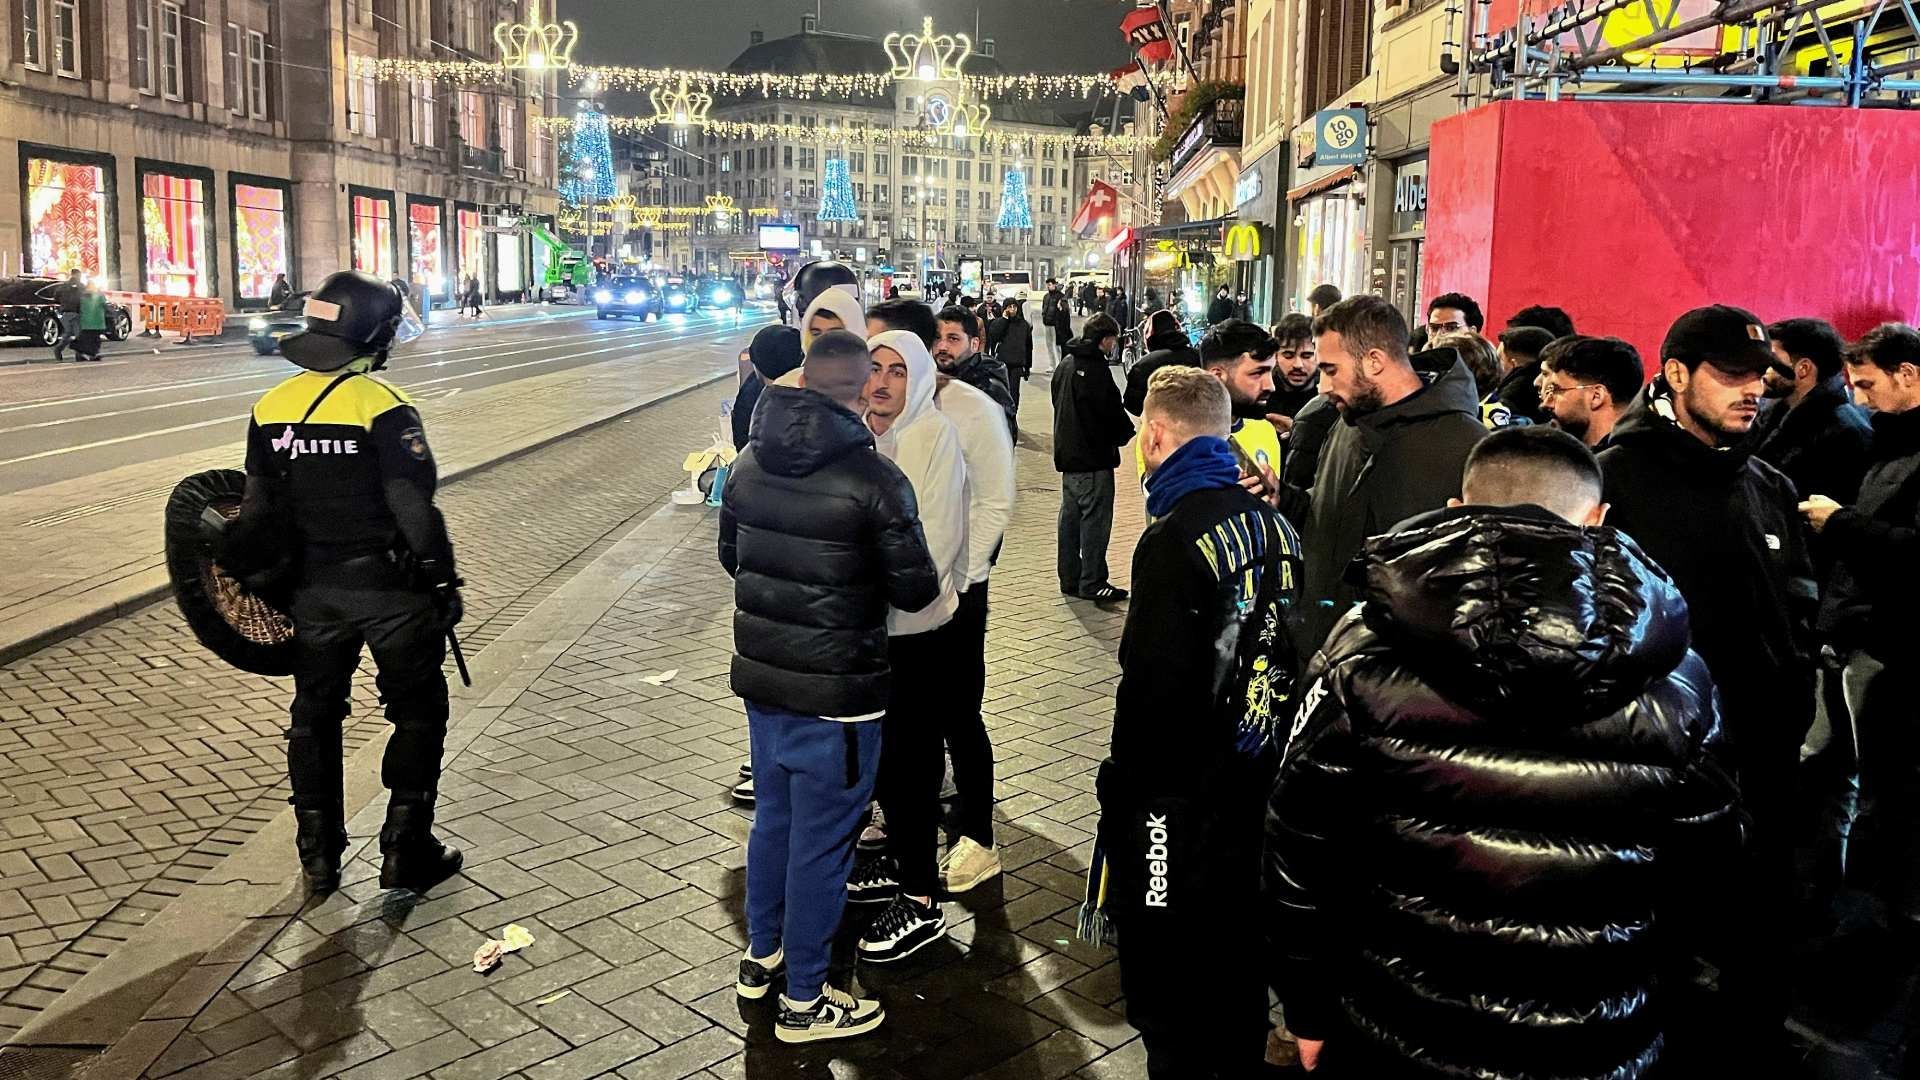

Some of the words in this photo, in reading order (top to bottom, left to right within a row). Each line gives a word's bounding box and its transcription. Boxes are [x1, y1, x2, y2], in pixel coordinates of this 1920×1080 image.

[1330, 120, 1347, 133] to
[1336, 128, 1354, 146] go
[1145, 812, 1168, 907] Reebok
